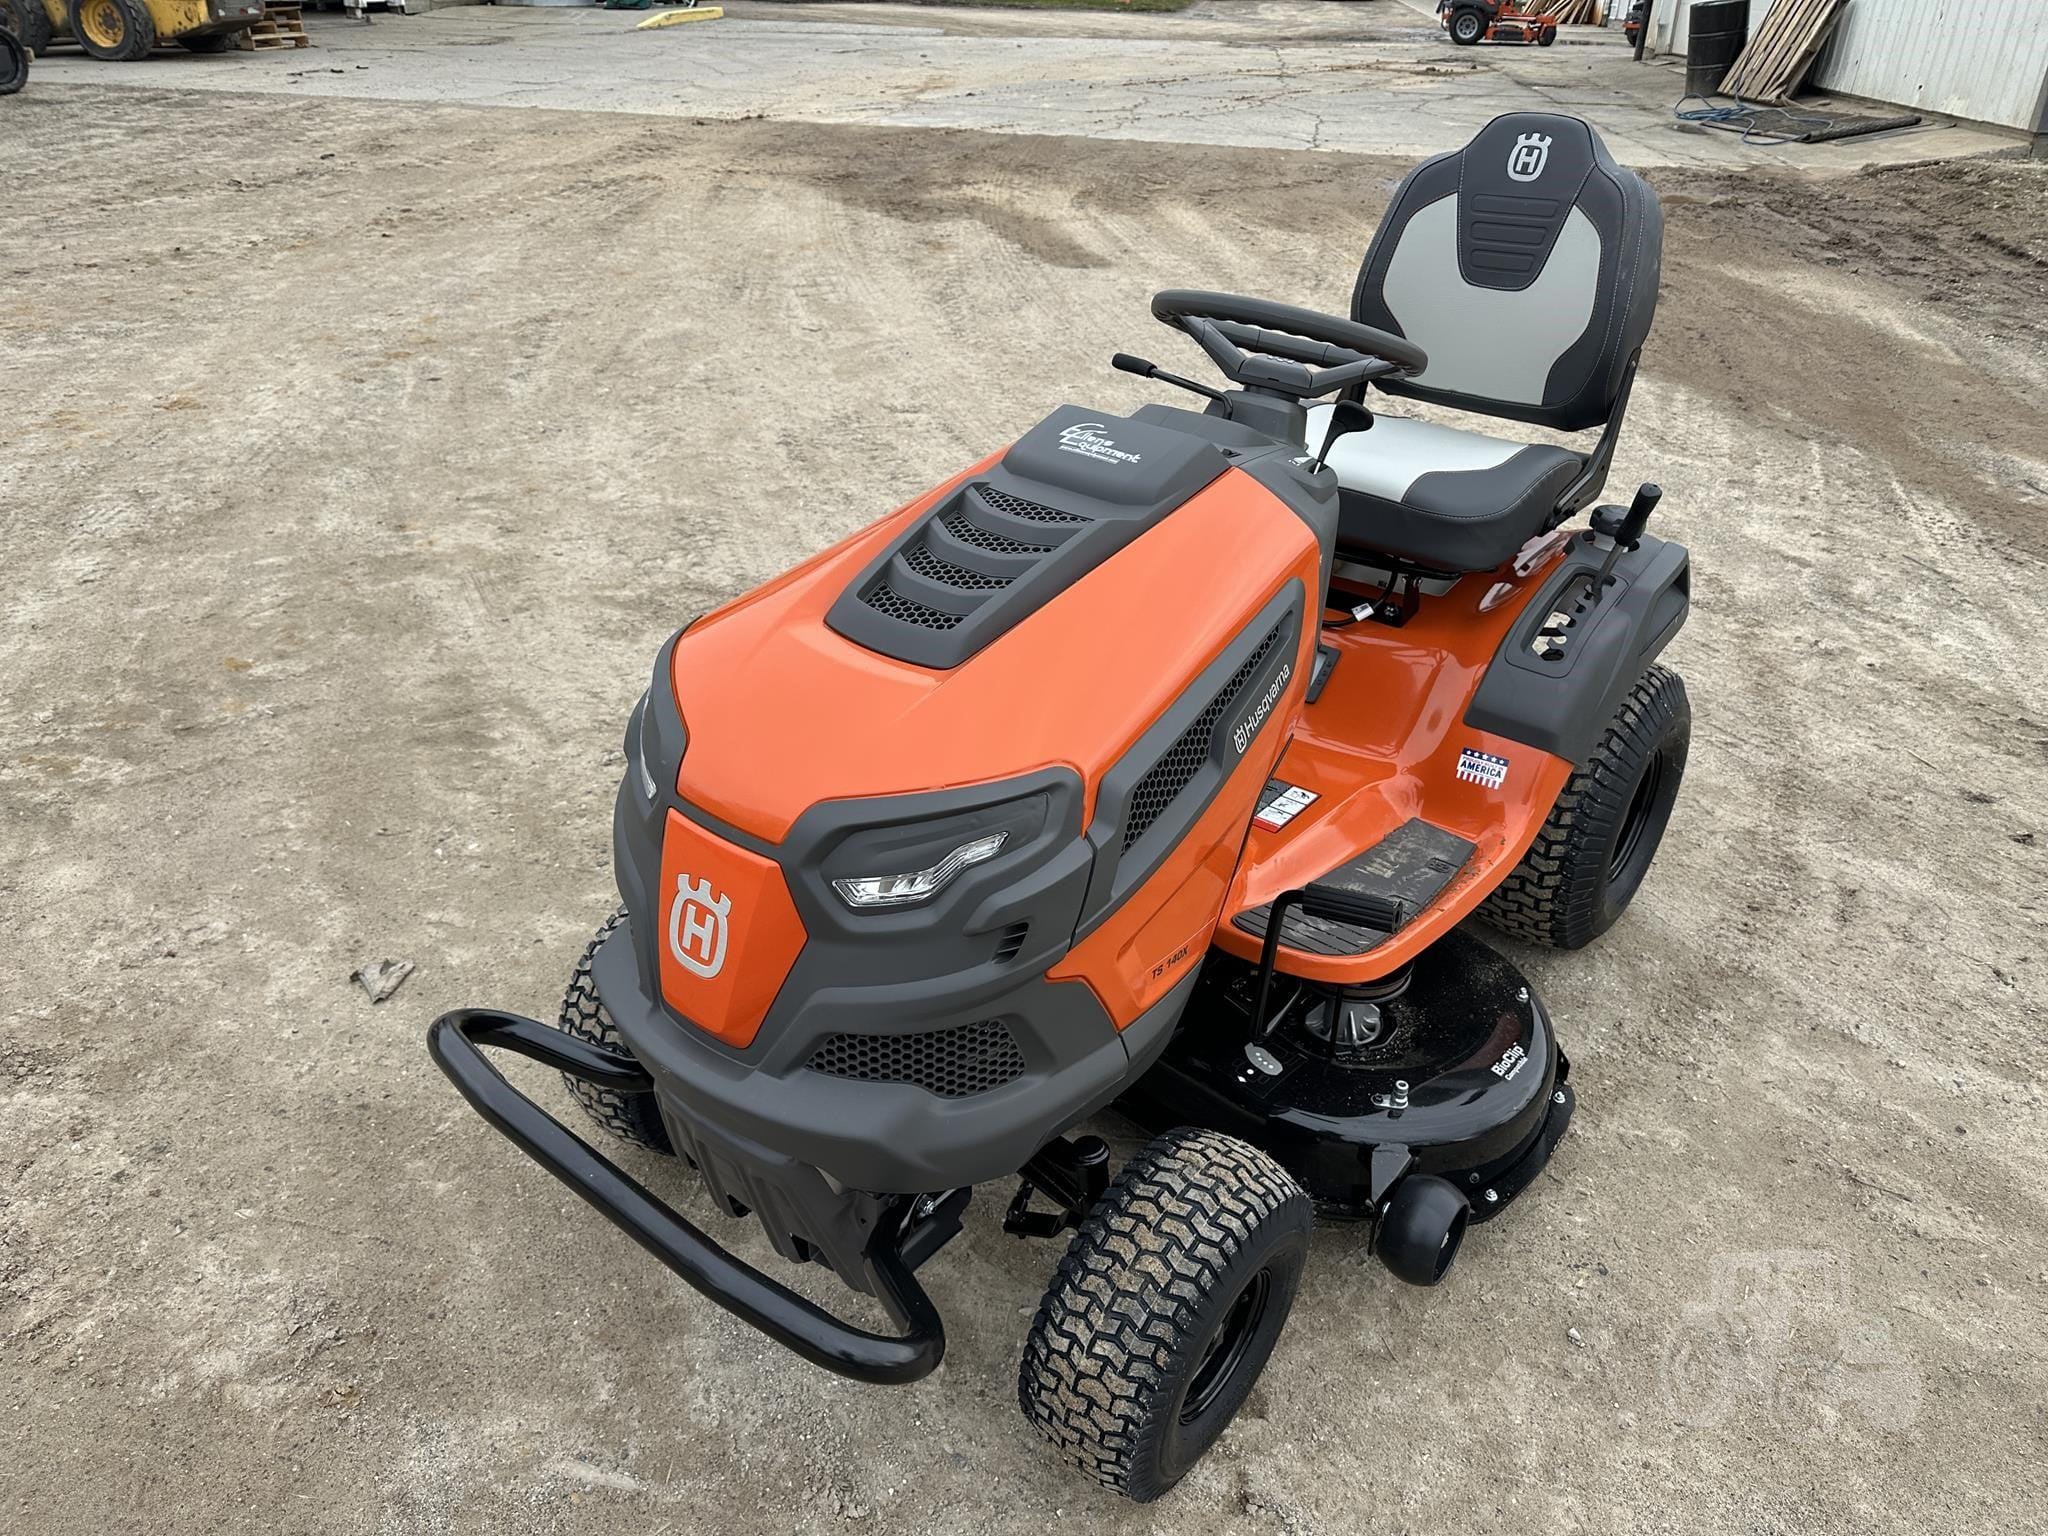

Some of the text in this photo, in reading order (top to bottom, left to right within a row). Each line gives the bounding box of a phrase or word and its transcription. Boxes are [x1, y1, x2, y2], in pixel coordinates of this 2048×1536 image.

[1059, 430, 1141, 463] Equipment
[1244, 664, 1290, 738] Husqvarna
[1460, 760, 1502, 779] AMERICA
[1151, 944, 1189, 980] TS 140X
[1491, 1044, 1526, 1077] BioClip
